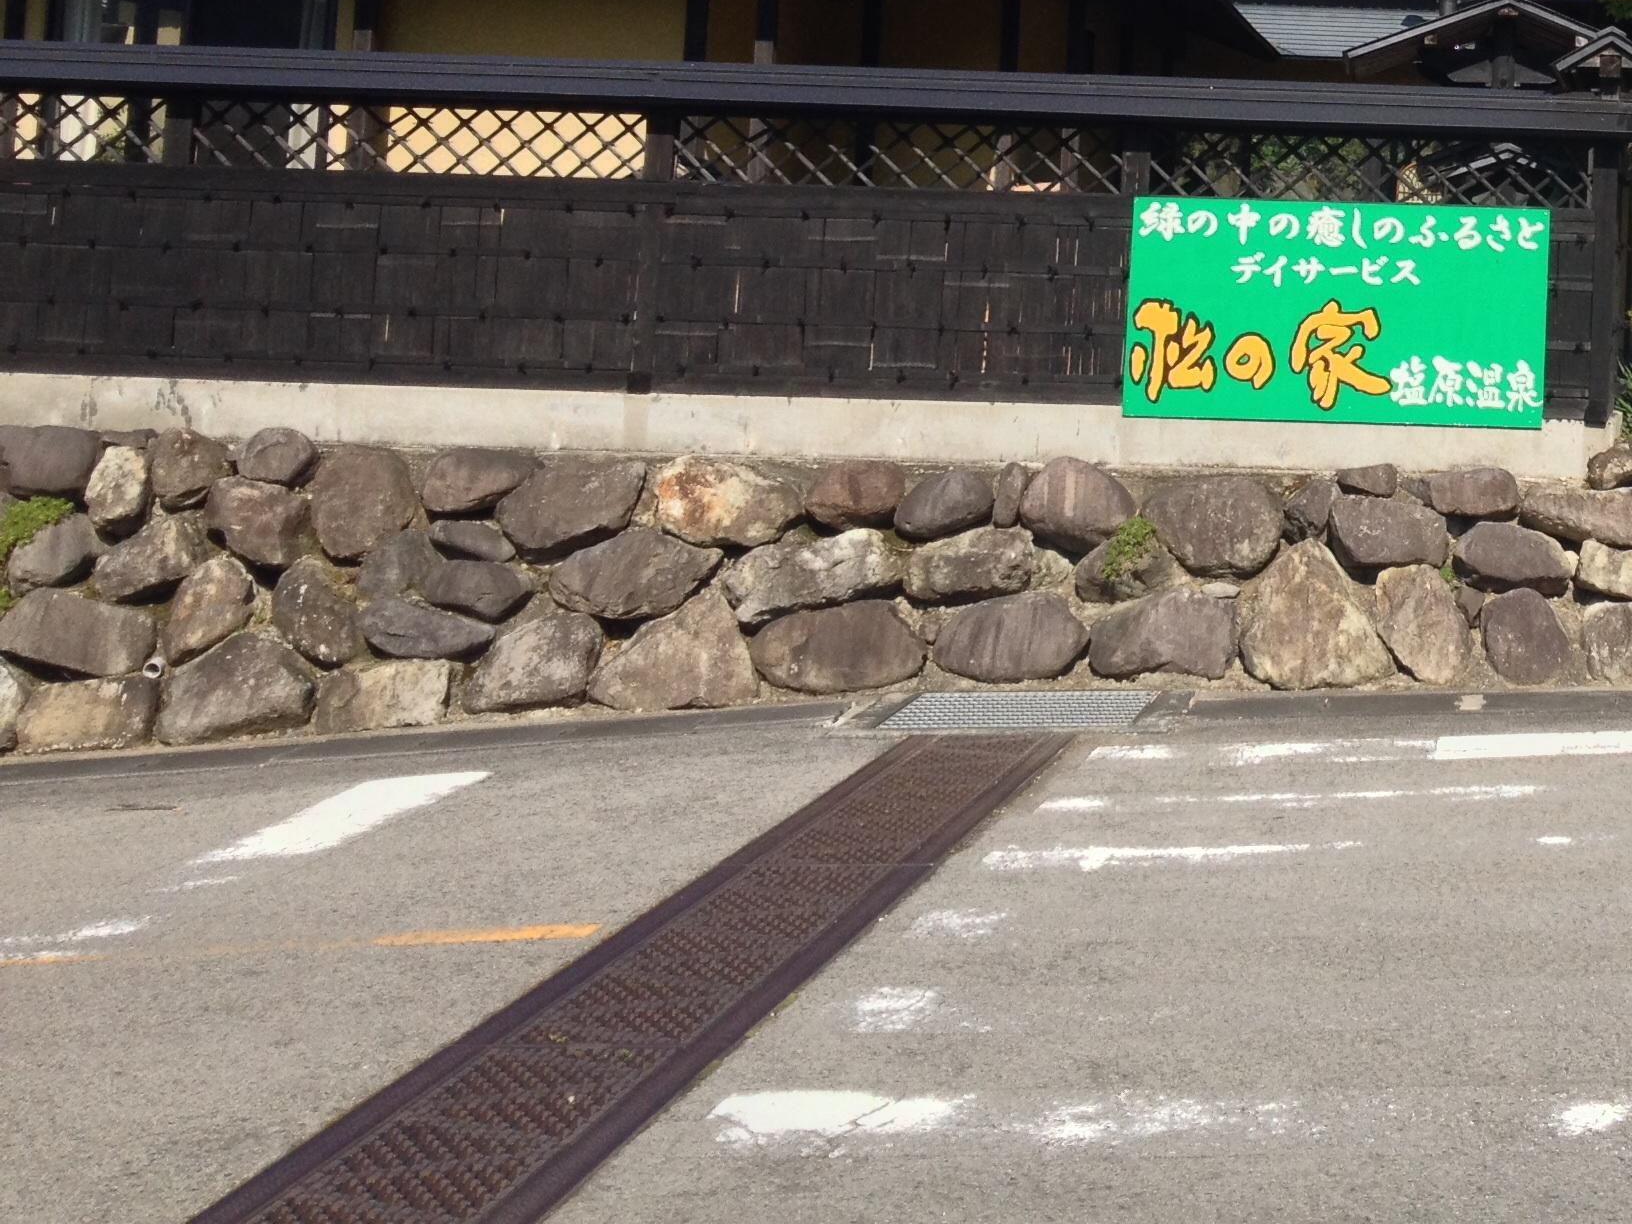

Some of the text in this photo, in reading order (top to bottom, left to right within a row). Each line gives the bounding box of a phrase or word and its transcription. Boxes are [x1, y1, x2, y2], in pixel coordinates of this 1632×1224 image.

[1139, 201, 1546, 253] 緑の中の癒しのふるさと
[1230, 251, 1422, 288] デイサービス
[1129, 298, 1392, 411] 松の家
[1389, 355, 1544, 413] 塩原温泉
